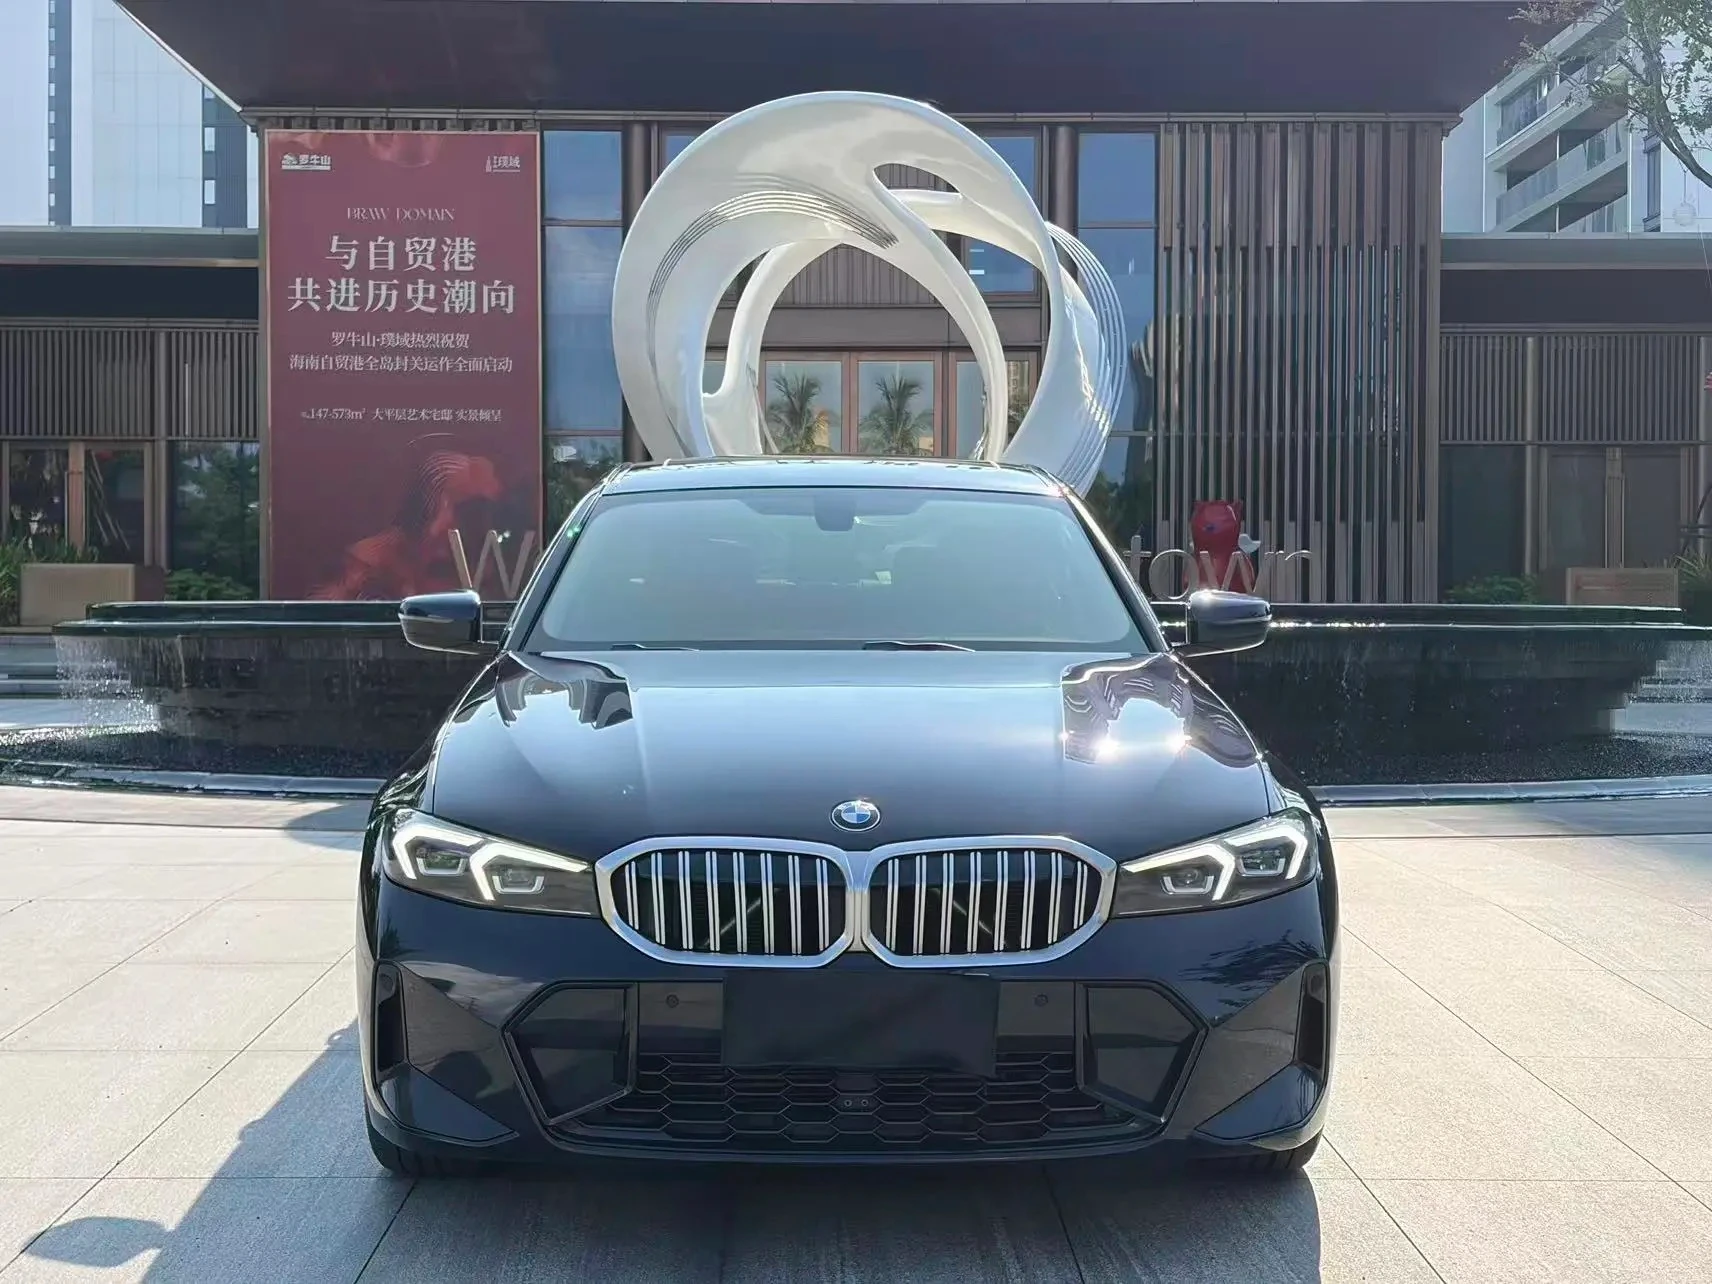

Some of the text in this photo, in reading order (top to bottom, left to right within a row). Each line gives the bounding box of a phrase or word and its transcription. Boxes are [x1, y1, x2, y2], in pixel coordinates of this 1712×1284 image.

[396, 207, 455, 220] DOMAIN
[325, 235, 477, 271] 与自贸港
[287, 277, 515, 314] 共进历史潮向
[289, 354, 513, 373] 海南自贸港全岛封关运作全面启动
[447, 528, 541, 599] W
